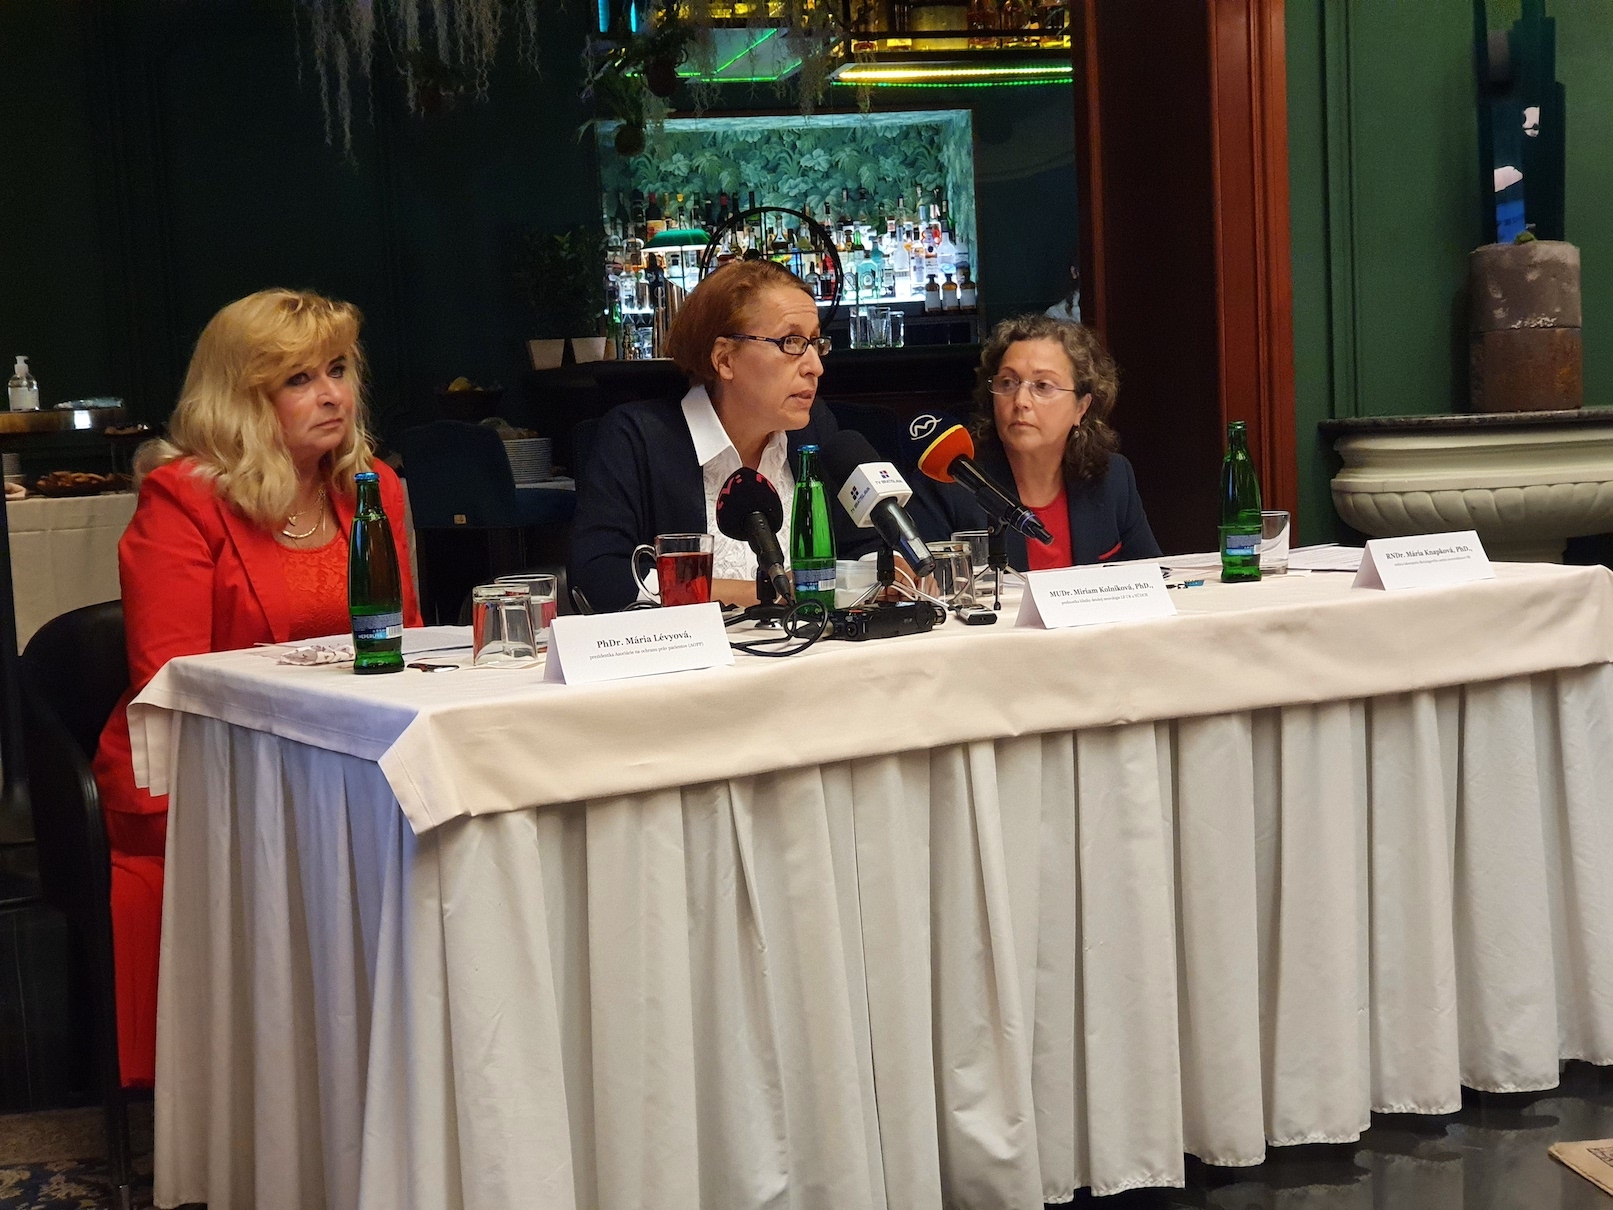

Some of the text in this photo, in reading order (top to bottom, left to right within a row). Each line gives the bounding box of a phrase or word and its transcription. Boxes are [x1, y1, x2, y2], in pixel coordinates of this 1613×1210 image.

[1385, 552, 1406, 560] RNDr.
[1424, 547, 1456, 556] Knapková,
[1049, 590, 1073, 598] MUDr.
[1073, 587, 1099, 596] Miriam
[1099, 583, 1135, 594] Kolníková,
[596, 630, 692, 649] PhDr. Mária Lévyová,
